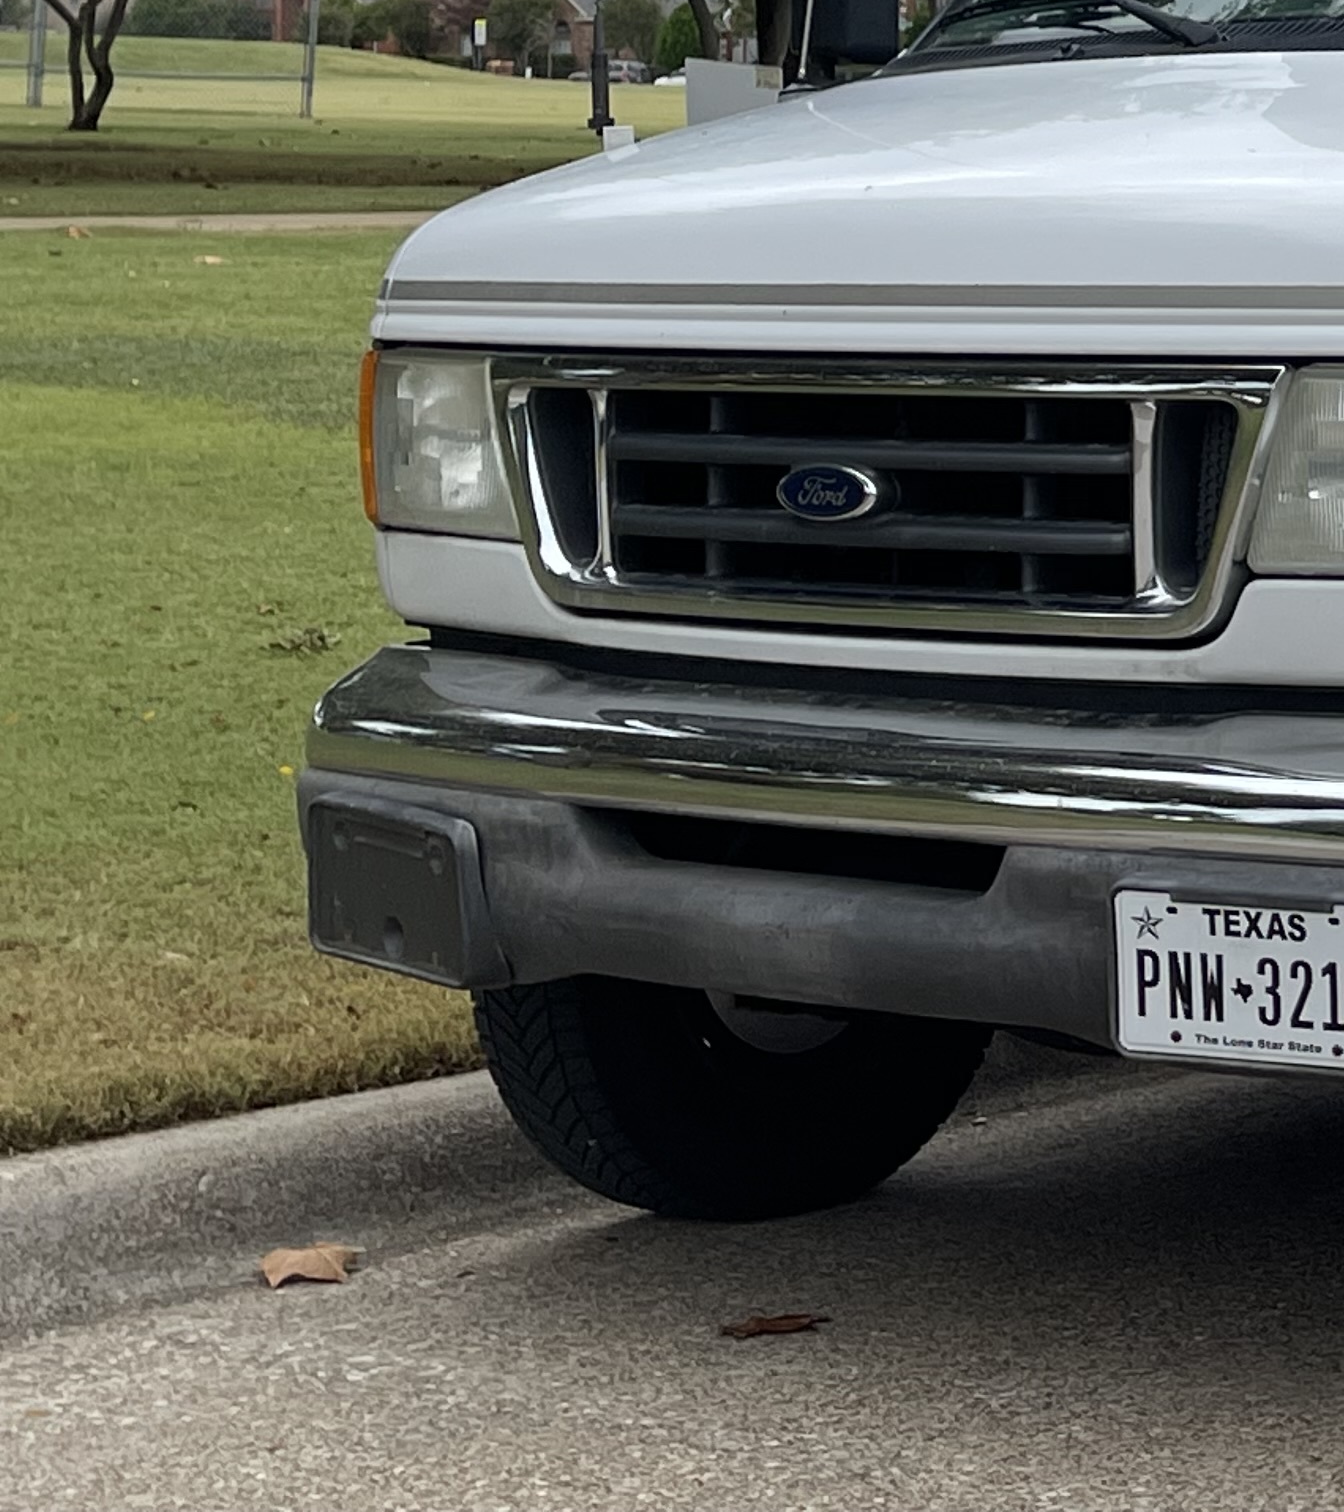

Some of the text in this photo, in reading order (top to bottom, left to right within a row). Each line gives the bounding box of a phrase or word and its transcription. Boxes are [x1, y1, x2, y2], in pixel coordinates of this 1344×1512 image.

[797, 475, 849, 506] Ford
[1201, 907, 1307, 942] TEXAS
[1135, 947, 1225, 1023] PNW
[1194, 1033, 1323, 1054] The Lone Star State
